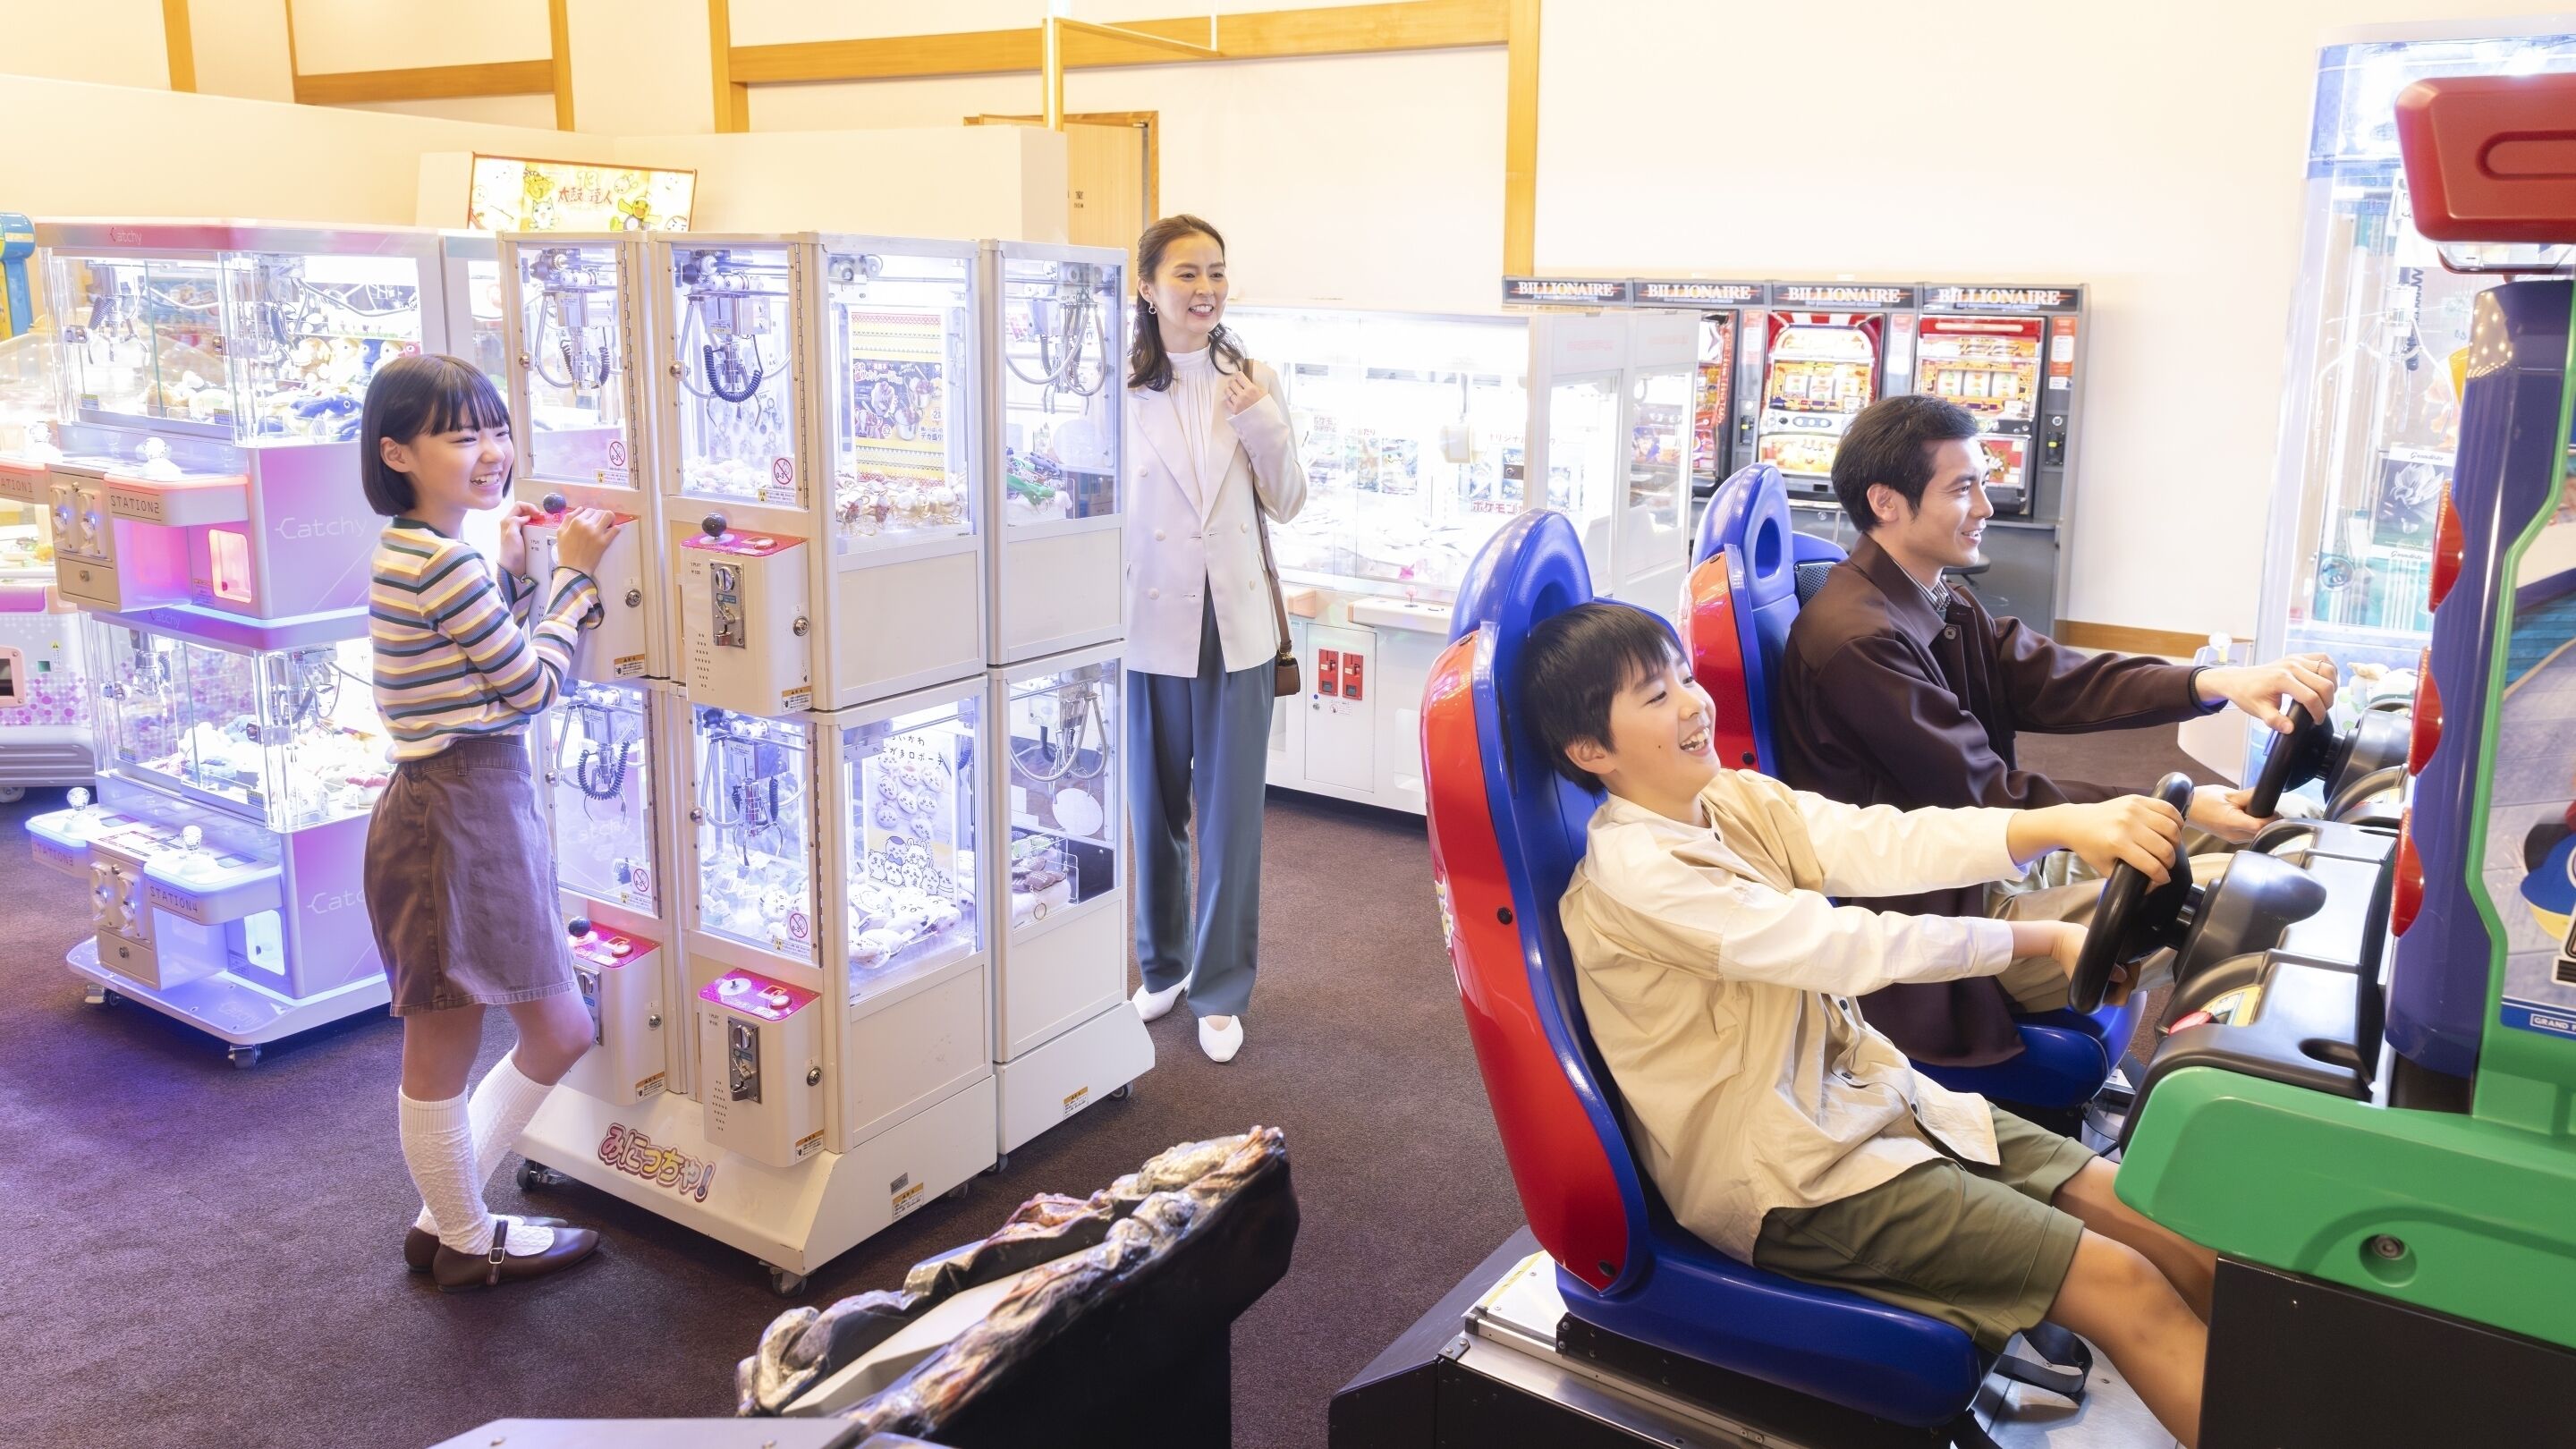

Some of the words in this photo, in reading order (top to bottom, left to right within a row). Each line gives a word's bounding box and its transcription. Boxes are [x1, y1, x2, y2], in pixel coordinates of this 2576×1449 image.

[1518, 281, 1614, 297] BILLIONAIRE
[1647, 284, 1751, 300] BILLIONAIRE
[1788, 286, 1901, 303] BILLIONAIRE
[1937, 287, 2062, 305] BILLIONAIRE
[110, 495, 160, 514] STATION2
[273, 516, 368, 540] Catchy
[149, 886, 199, 912] STATION4
[2534, 1017, 2569, 1030] GRAND
